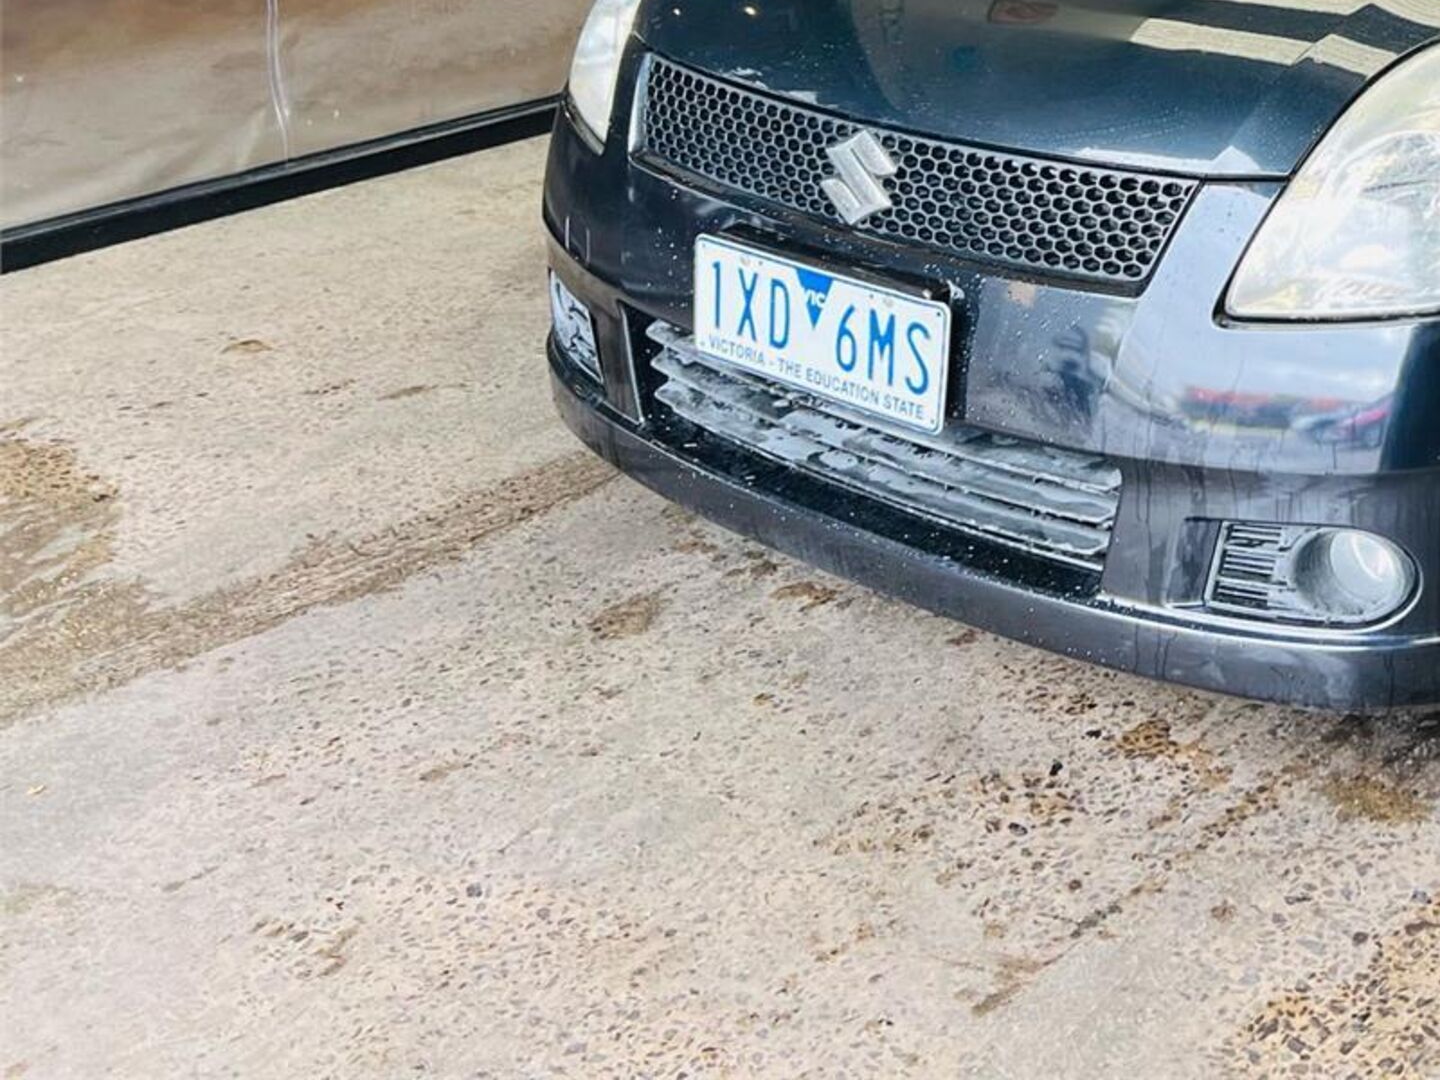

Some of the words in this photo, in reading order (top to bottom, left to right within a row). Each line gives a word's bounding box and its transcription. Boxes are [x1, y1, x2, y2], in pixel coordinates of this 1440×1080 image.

[709, 333, 766, 367] VICTORIA
[778, 356, 802, 379] THE
[805, 364, 879, 407] EDUCATION
[882, 394, 925, 421] STATE
[712, 260, 791, 350] 1XD
[835, 303, 932, 396] 6MS
